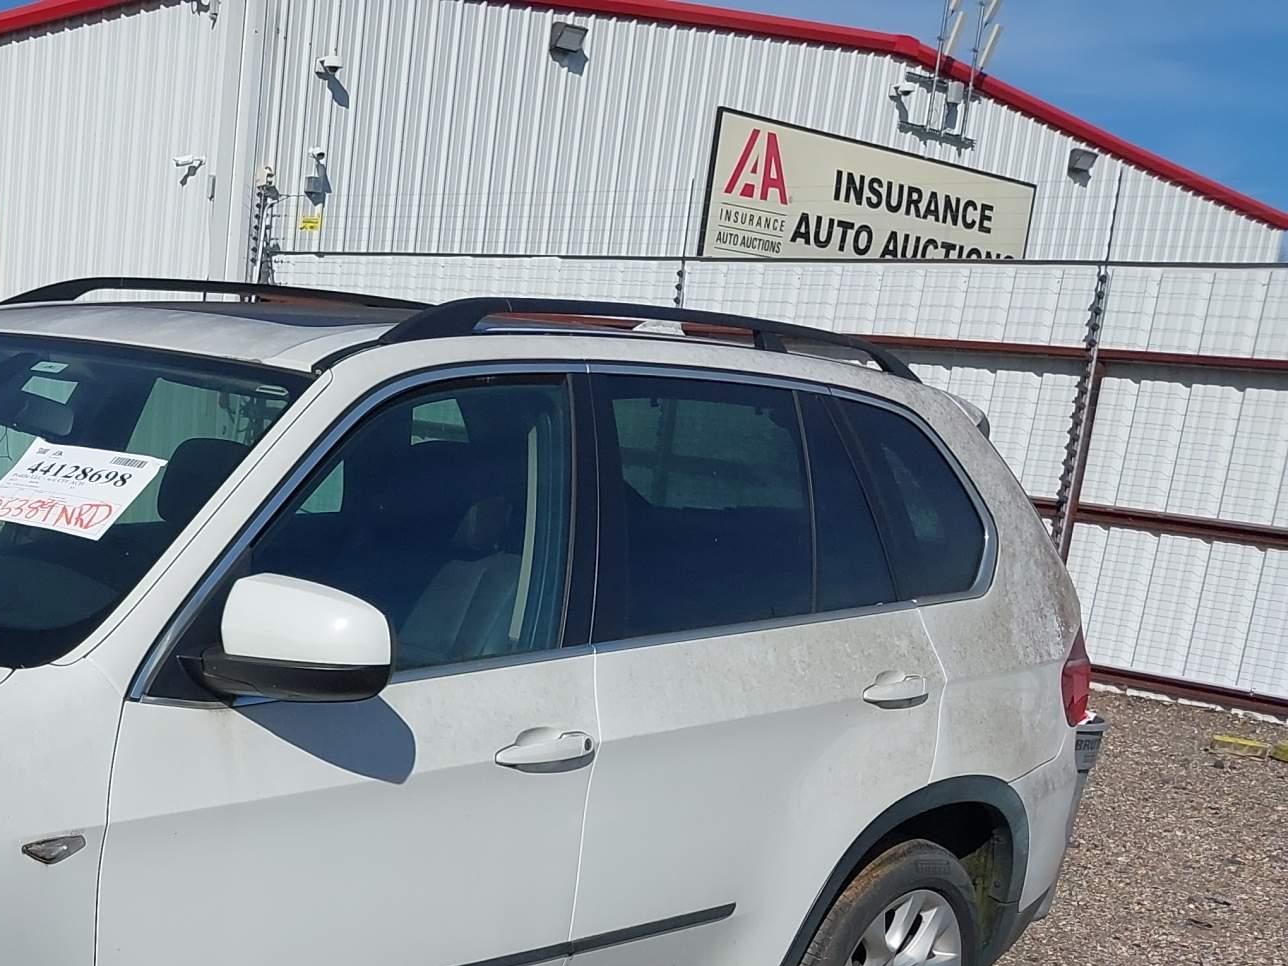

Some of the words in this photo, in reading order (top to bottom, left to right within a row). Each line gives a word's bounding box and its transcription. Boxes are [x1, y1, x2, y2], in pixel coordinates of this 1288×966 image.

[832, 169, 994, 234] INSURANCE
[719, 207, 786, 233] INSURANCE
[790, 212, 874, 256] AUTO
[715, 231, 739, 247] AUTO
[740, 234, 782, 254] AUCTIONS
[27, 460, 133, 488] 44128698
